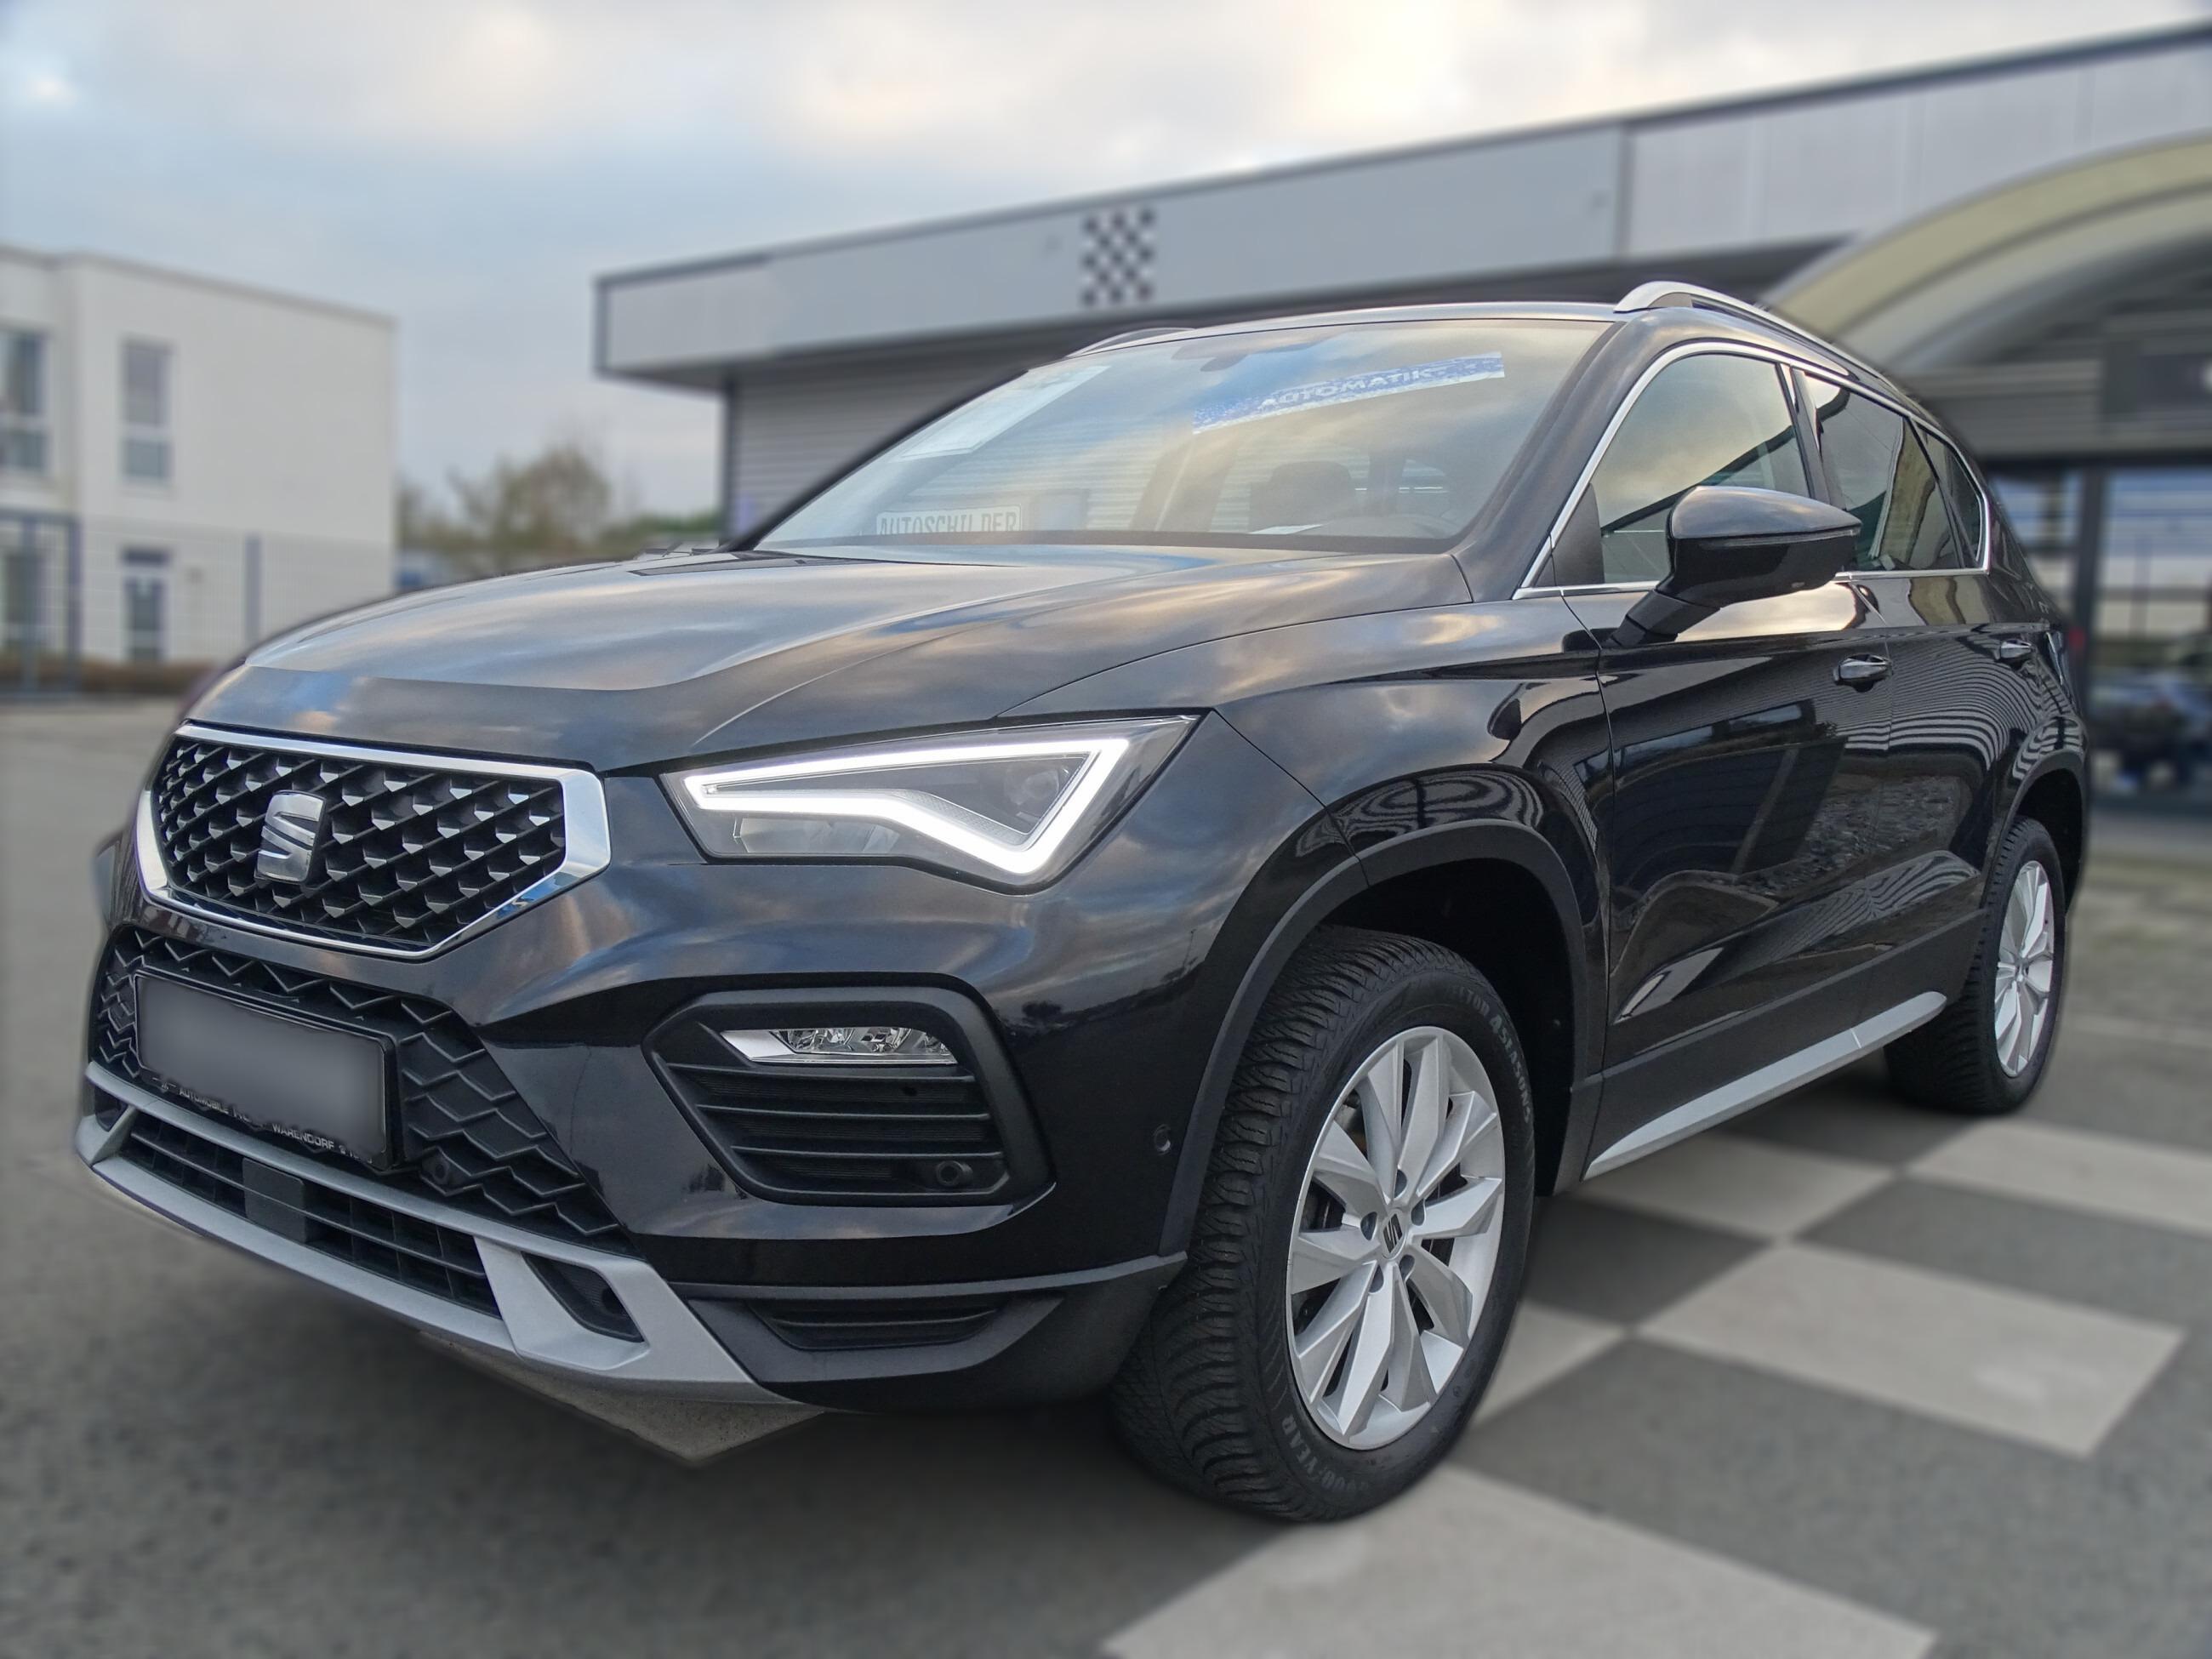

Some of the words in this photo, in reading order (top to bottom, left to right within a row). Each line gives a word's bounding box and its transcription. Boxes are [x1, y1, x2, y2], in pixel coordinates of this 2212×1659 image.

[1257, 370, 1432, 412] AUTOMATIK
[880, 511, 1017, 534] AUTOSCHILDER
[272, 1123, 334, 1149] WARENDORF
